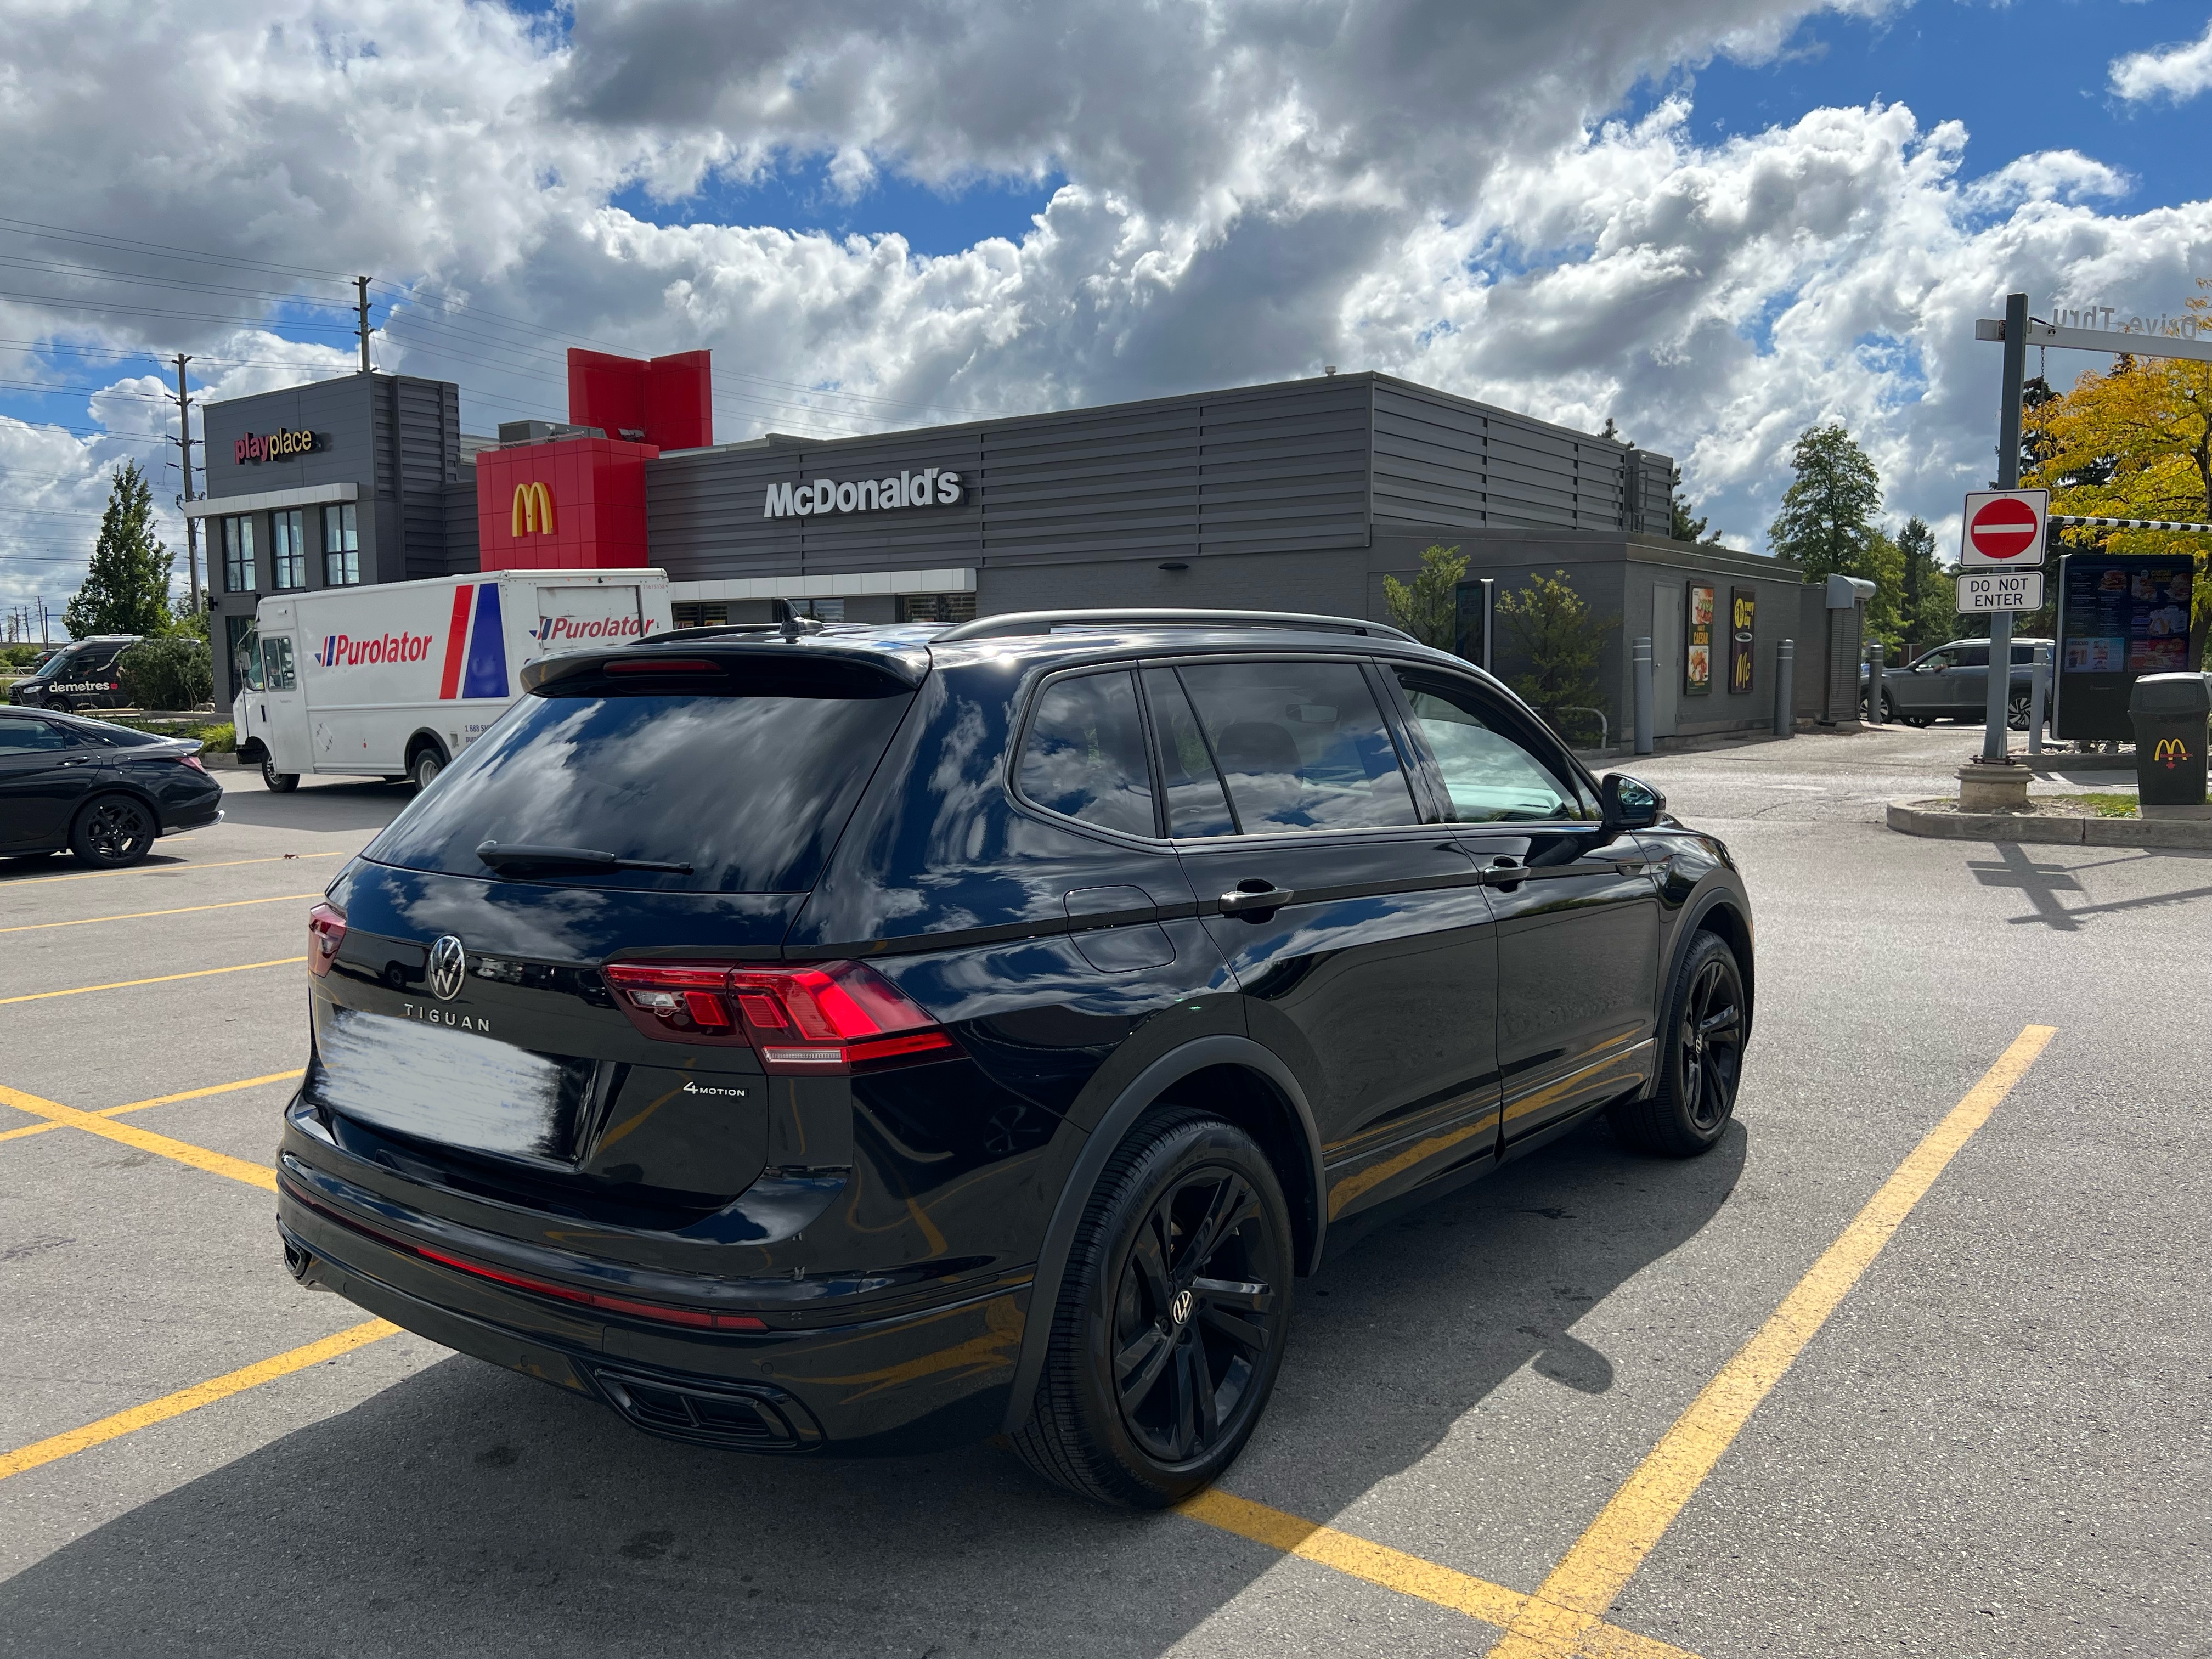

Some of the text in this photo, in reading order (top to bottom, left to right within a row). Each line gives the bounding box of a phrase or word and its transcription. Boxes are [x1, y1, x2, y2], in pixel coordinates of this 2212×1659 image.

[235, 427, 312, 465] playplace
[764, 467, 961, 518] McDonald's
[1971, 578, 2029, 592] DO NOT
[1975, 594, 2023, 607] ENTER
[551, 616, 654, 640] Purolator
[335, 631, 432, 666] Purolator
[49, 681, 110, 692] demetres
[404, 1003, 490, 1032] TIGUAN
[683, 1081, 745, 1096] 4MOTION
